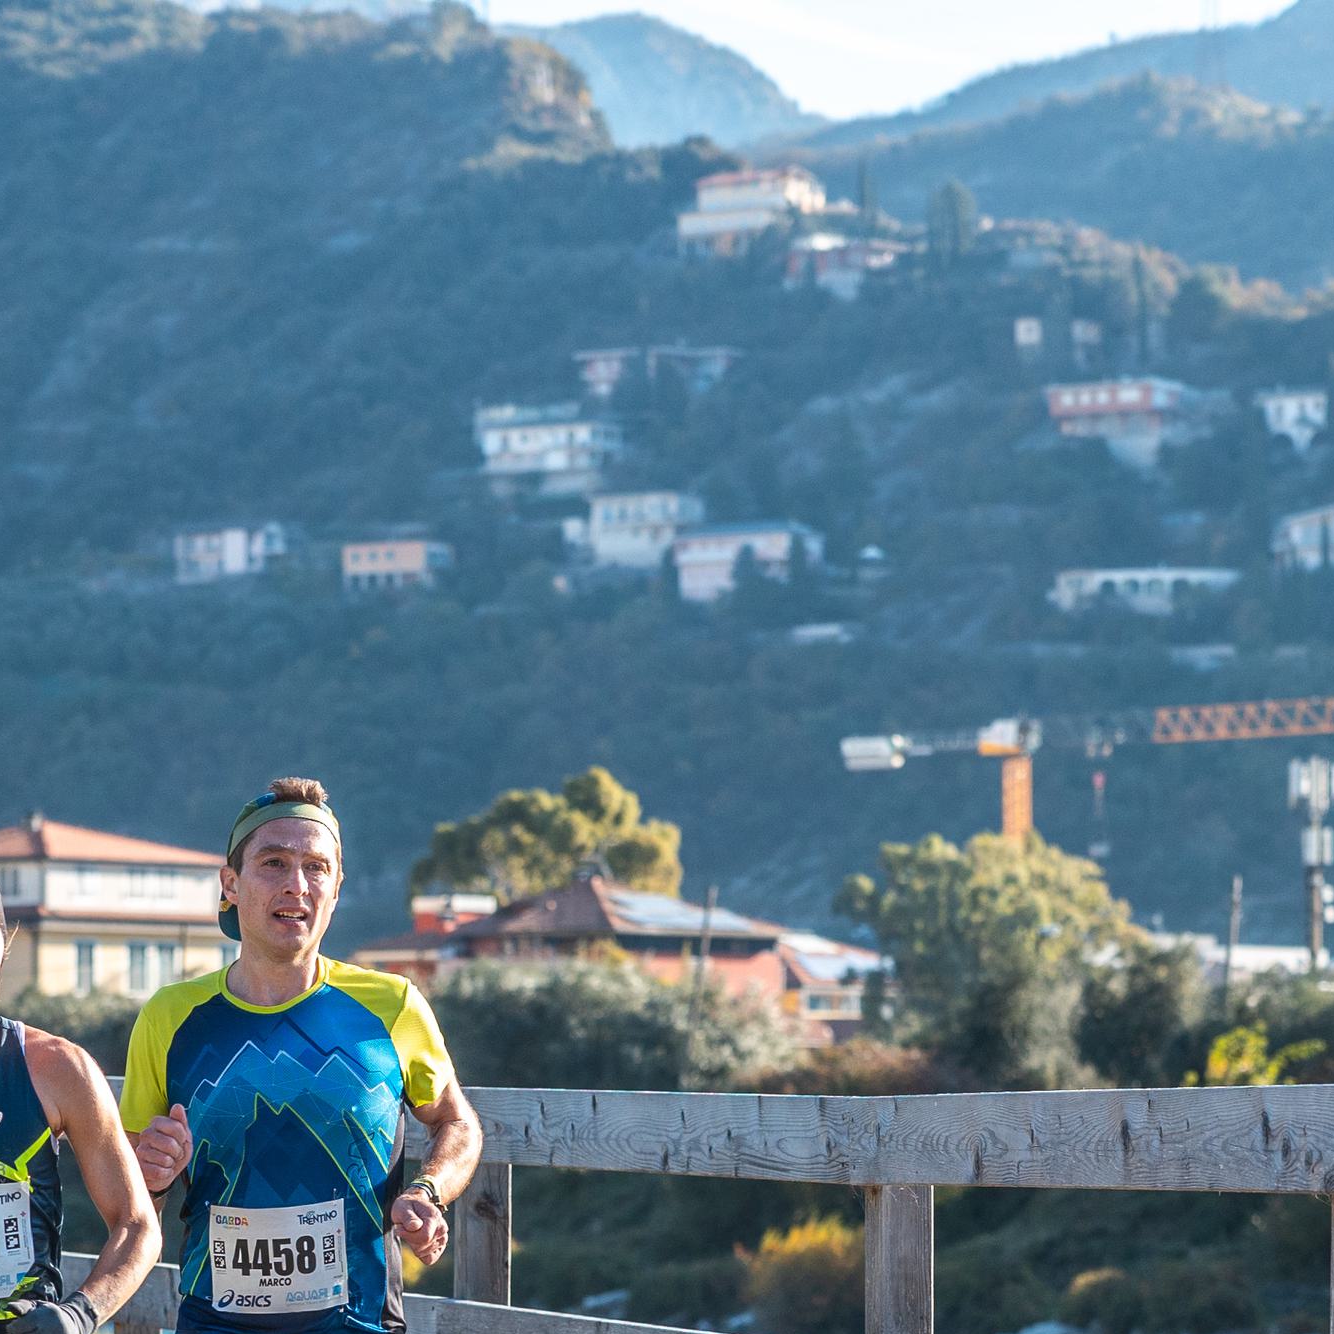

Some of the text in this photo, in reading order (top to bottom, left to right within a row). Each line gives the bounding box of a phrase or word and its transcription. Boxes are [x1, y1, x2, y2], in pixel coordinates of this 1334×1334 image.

[215, 1214, 249, 1226] GARDA
[297, 1210, 338, 1225] TRENTINO
[232, 1235, 317, 1277] 4458
[259, 1277, 292, 1287] MARCO
